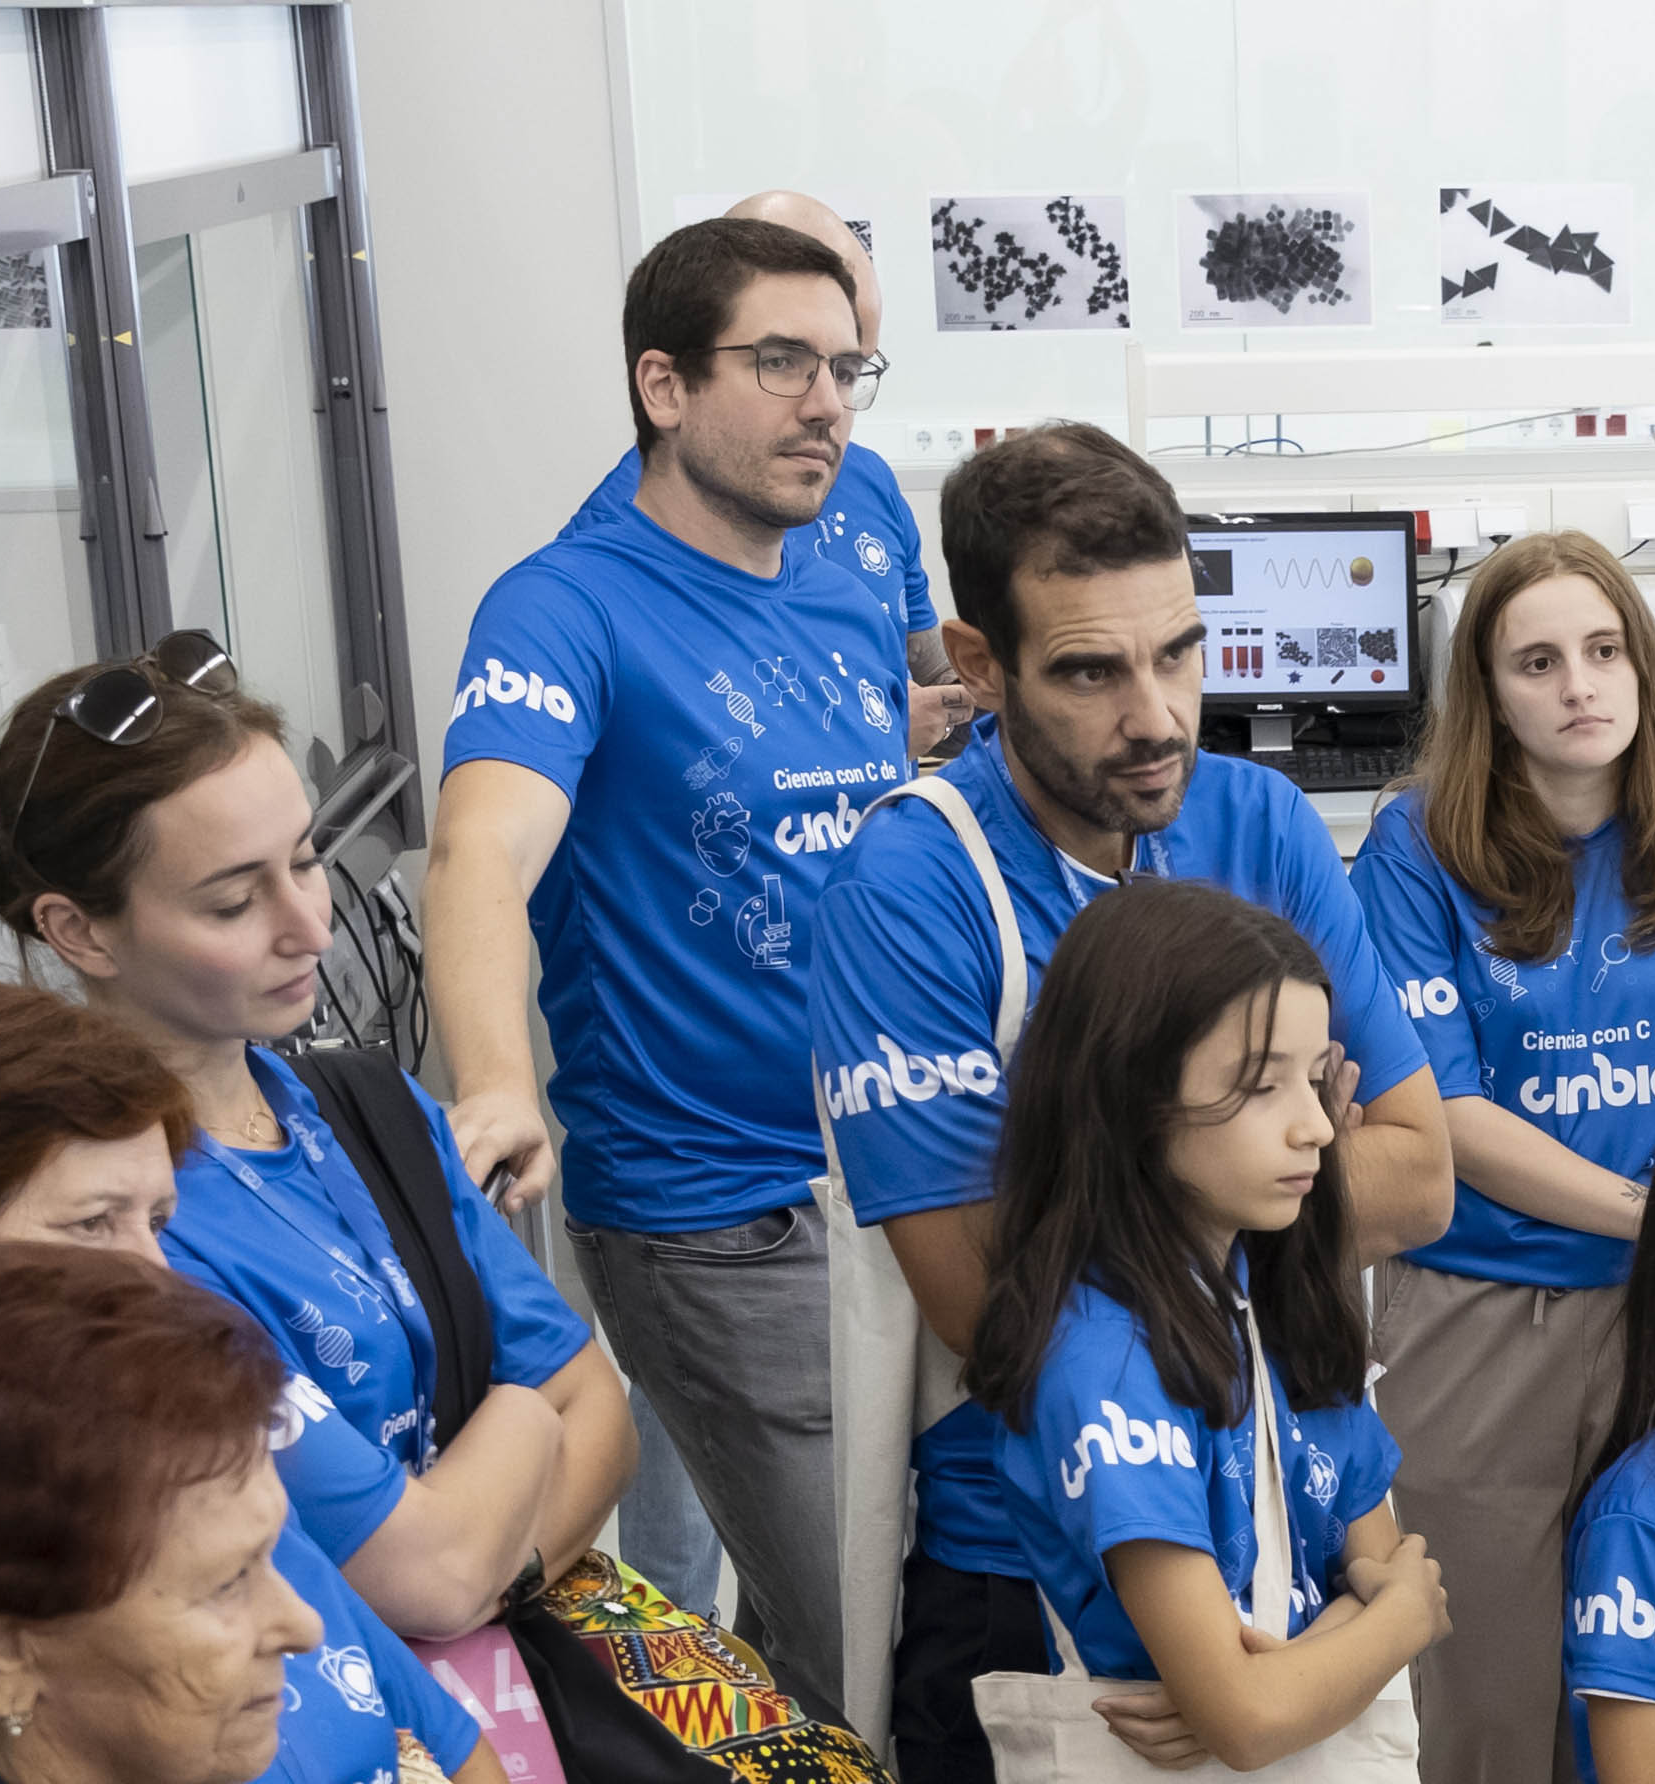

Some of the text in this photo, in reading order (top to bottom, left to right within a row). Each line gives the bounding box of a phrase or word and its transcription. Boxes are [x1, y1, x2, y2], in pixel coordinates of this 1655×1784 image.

[448, 657, 576, 728] inbio
[773, 759, 897, 790] Ciencia con C de
[773, 792, 868, 855] cinb
[1522, 1028, 1588, 1051] Ciencia
[1592, 1024, 1630, 1046] con
[1635, 1018, 1650, 1039] C
[822, 1034, 1001, 1121] cinbio
